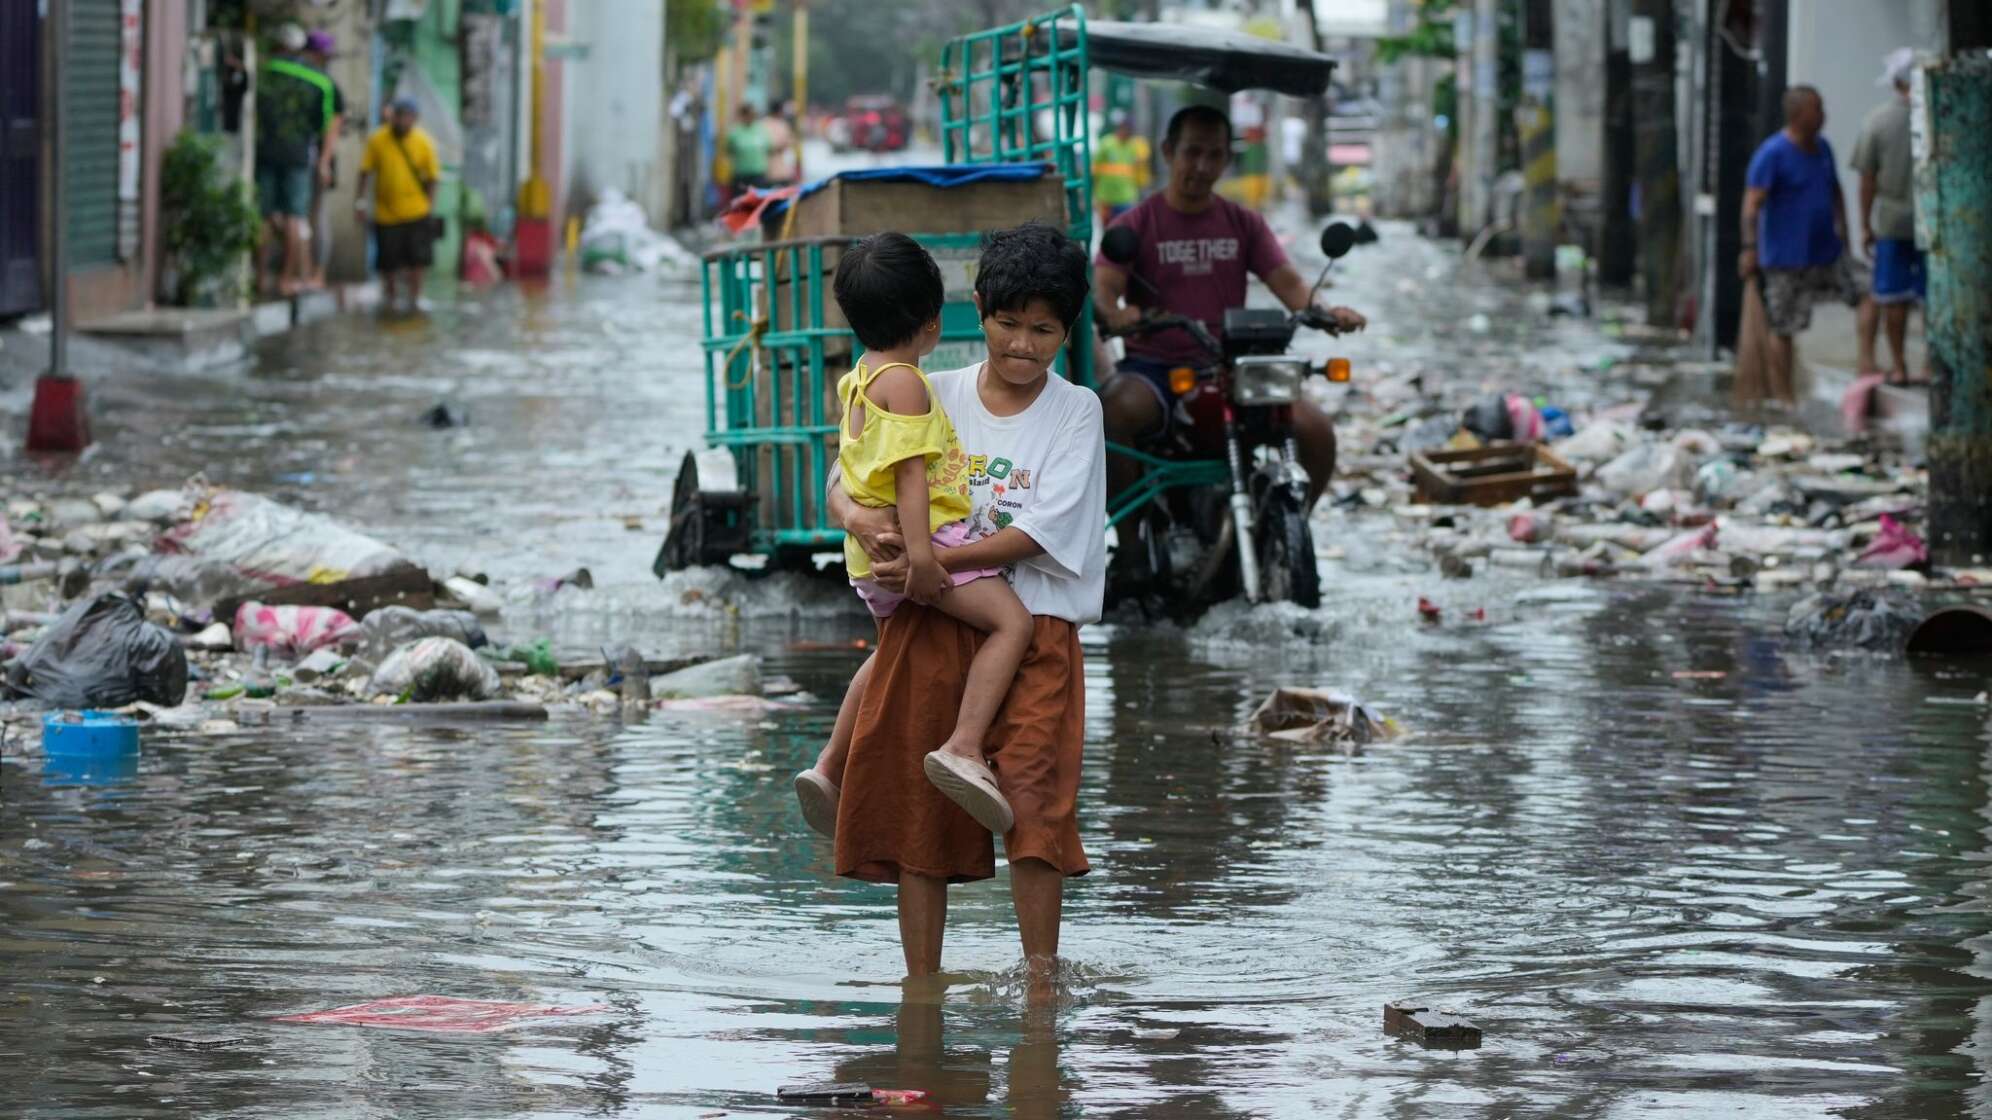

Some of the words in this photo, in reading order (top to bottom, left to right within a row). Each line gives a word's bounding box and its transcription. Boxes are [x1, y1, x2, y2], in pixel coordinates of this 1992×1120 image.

[1156, 239, 1239, 264] TOGETHER
[968, 455, 1032, 489] RON
[997, 500, 1022, 509] CORON
